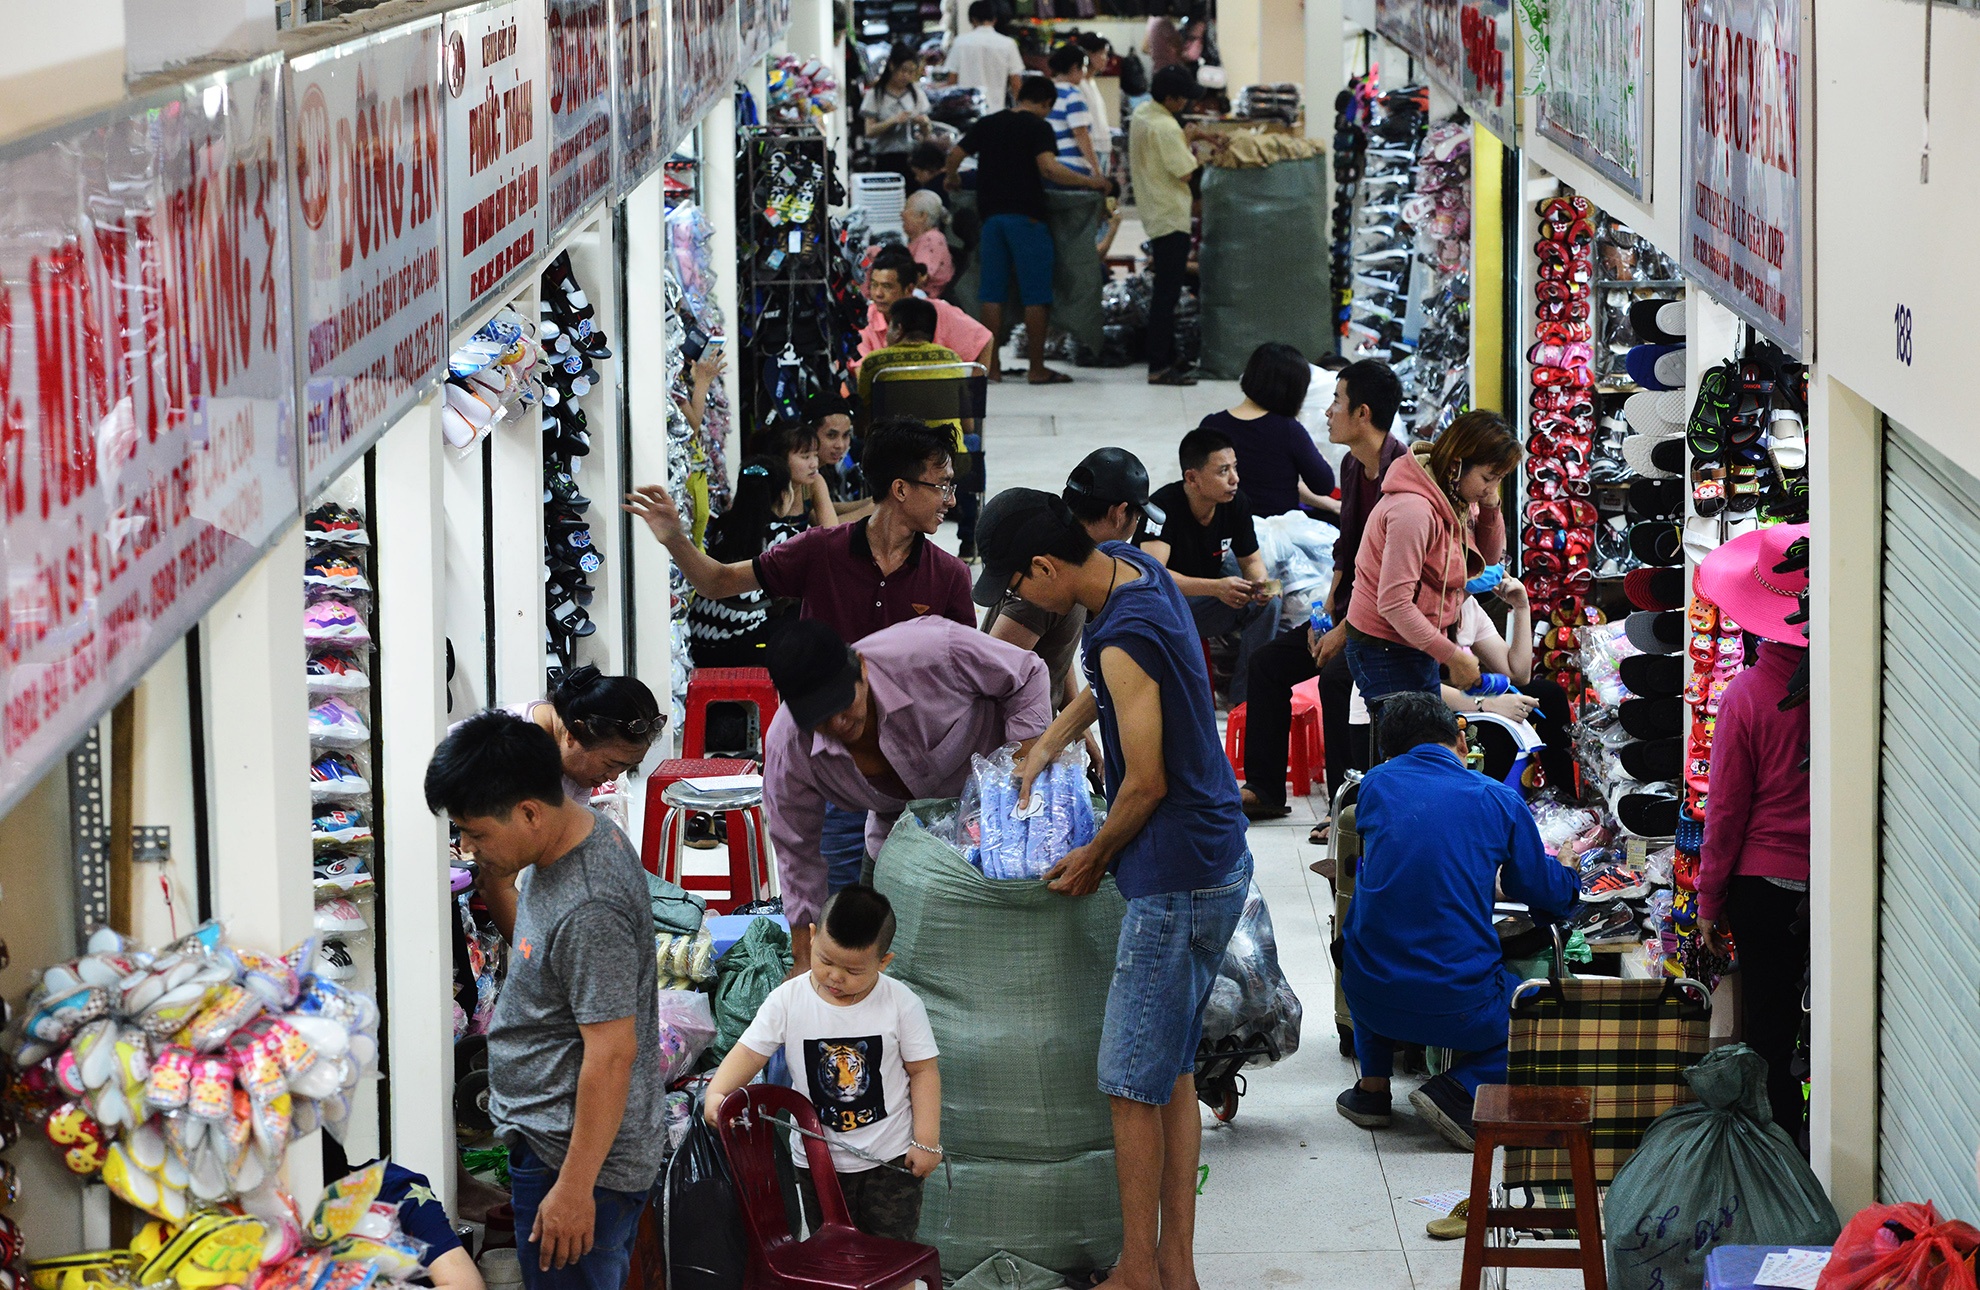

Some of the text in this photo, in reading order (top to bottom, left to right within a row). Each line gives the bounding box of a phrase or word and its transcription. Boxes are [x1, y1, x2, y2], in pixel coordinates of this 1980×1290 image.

[469, 76, 501, 176] PHƯỚC
[503, 69, 533, 154] THÀNH
[1700, 20, 1743, 176] NGỌC
[336, 62, 405, 271] ĐÔNG
[410, 84, 439, 229] AN
[1731, 202, 1737, 240] &
[1747, 207, 1766, 259] GIÀY
[1768, 217, 1784, 270] DÉP
[341, 306, 356, 351] BÁN
[366, 293, 371, 334] &
[372, 269, 381, 329] LẺ
[383, 267, 396, 321] GIÀY
[399, 265, 411, 310] DÉP
[413, 255, 424, 299] CÁC
[425, 246, 439, 293] LOẠI
[1894, 303, 1912, 367] 188
